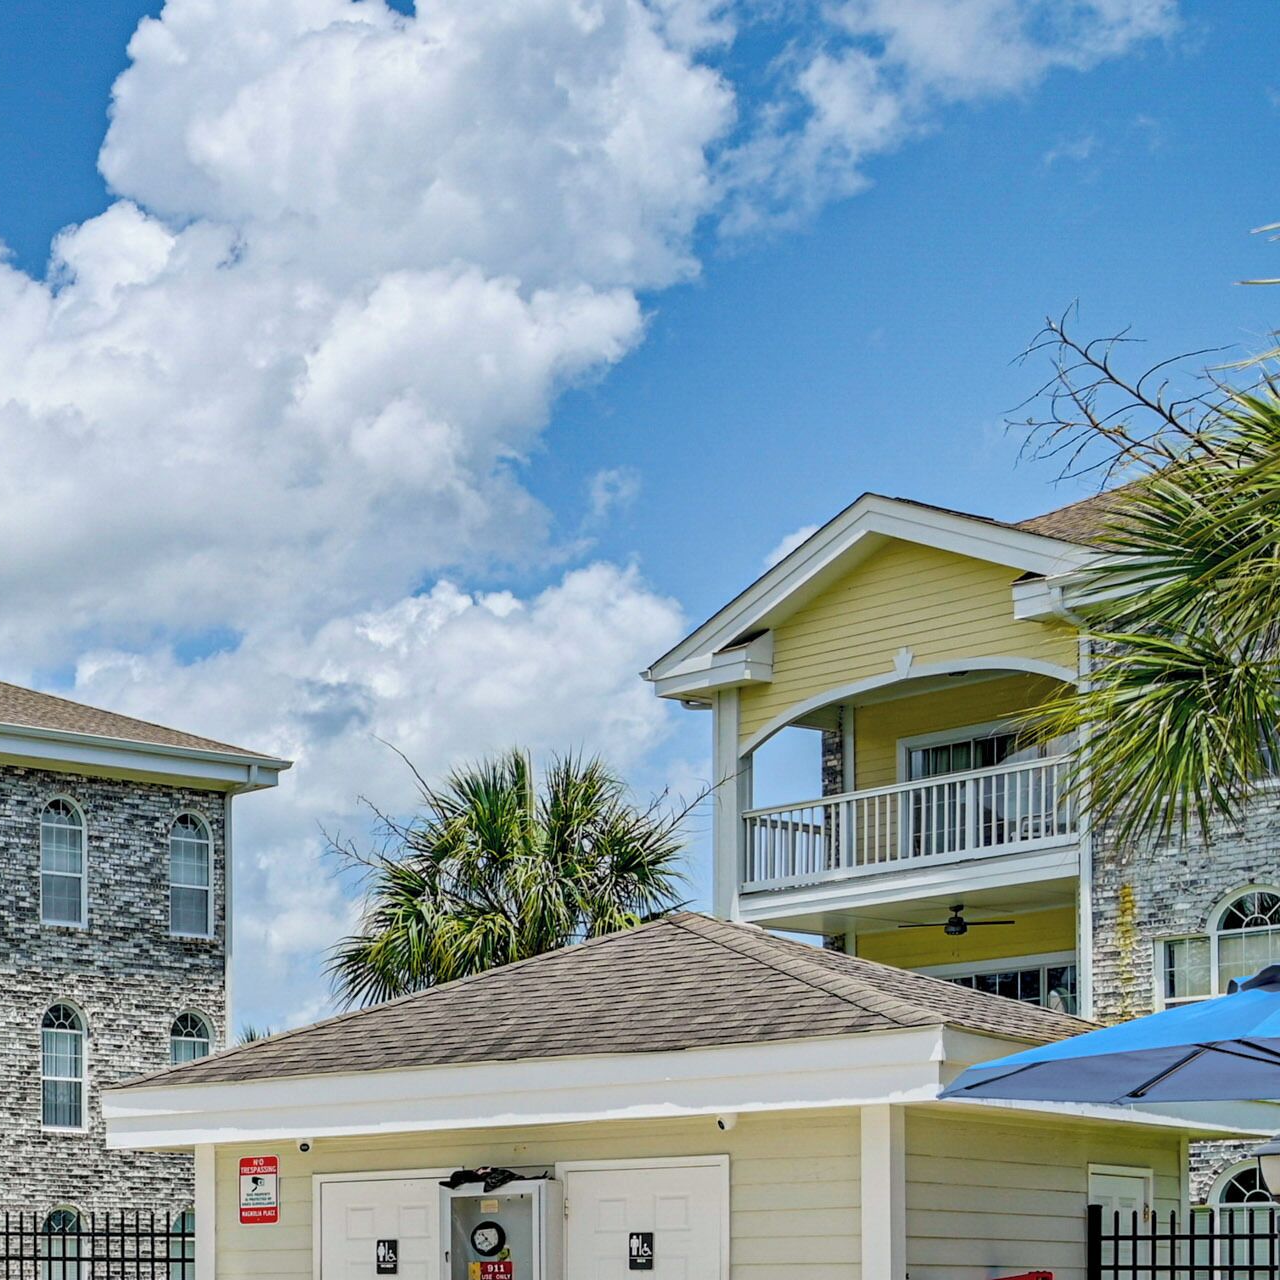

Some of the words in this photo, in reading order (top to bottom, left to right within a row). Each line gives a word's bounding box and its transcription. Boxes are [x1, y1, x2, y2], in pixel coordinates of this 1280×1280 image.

[253, 1158, 264, 1166] NO
[241, 1166, 277, 1174] TRESPASSING
[487, 1264, 505, 1273] 911
